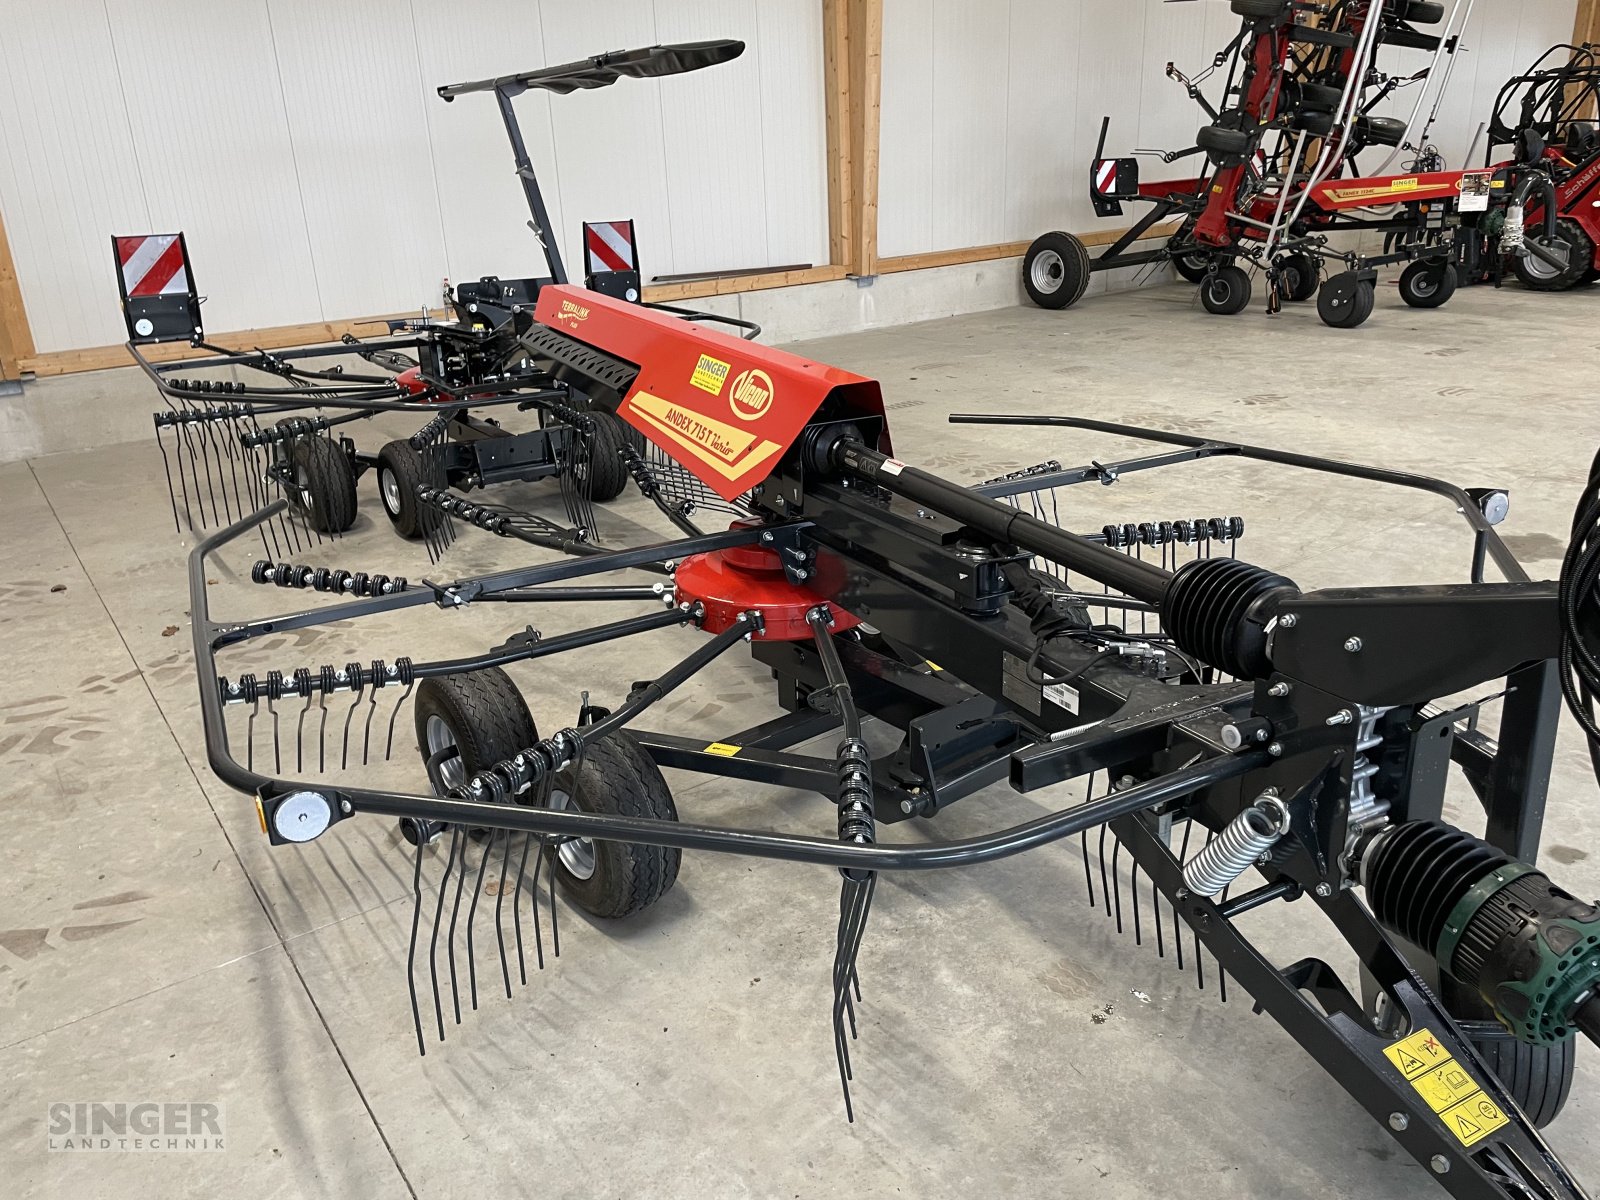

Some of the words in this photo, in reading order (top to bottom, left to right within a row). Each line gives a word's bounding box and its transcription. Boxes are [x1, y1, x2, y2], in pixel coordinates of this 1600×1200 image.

[562, 300, 590, 317] TERRALINK
[698, 357, 728, 379] SINGER
[734, 370, 770, 410] Vicon
[665, 407, 693, 433] ANDEX
[710, 432, 735, 456] Vario
